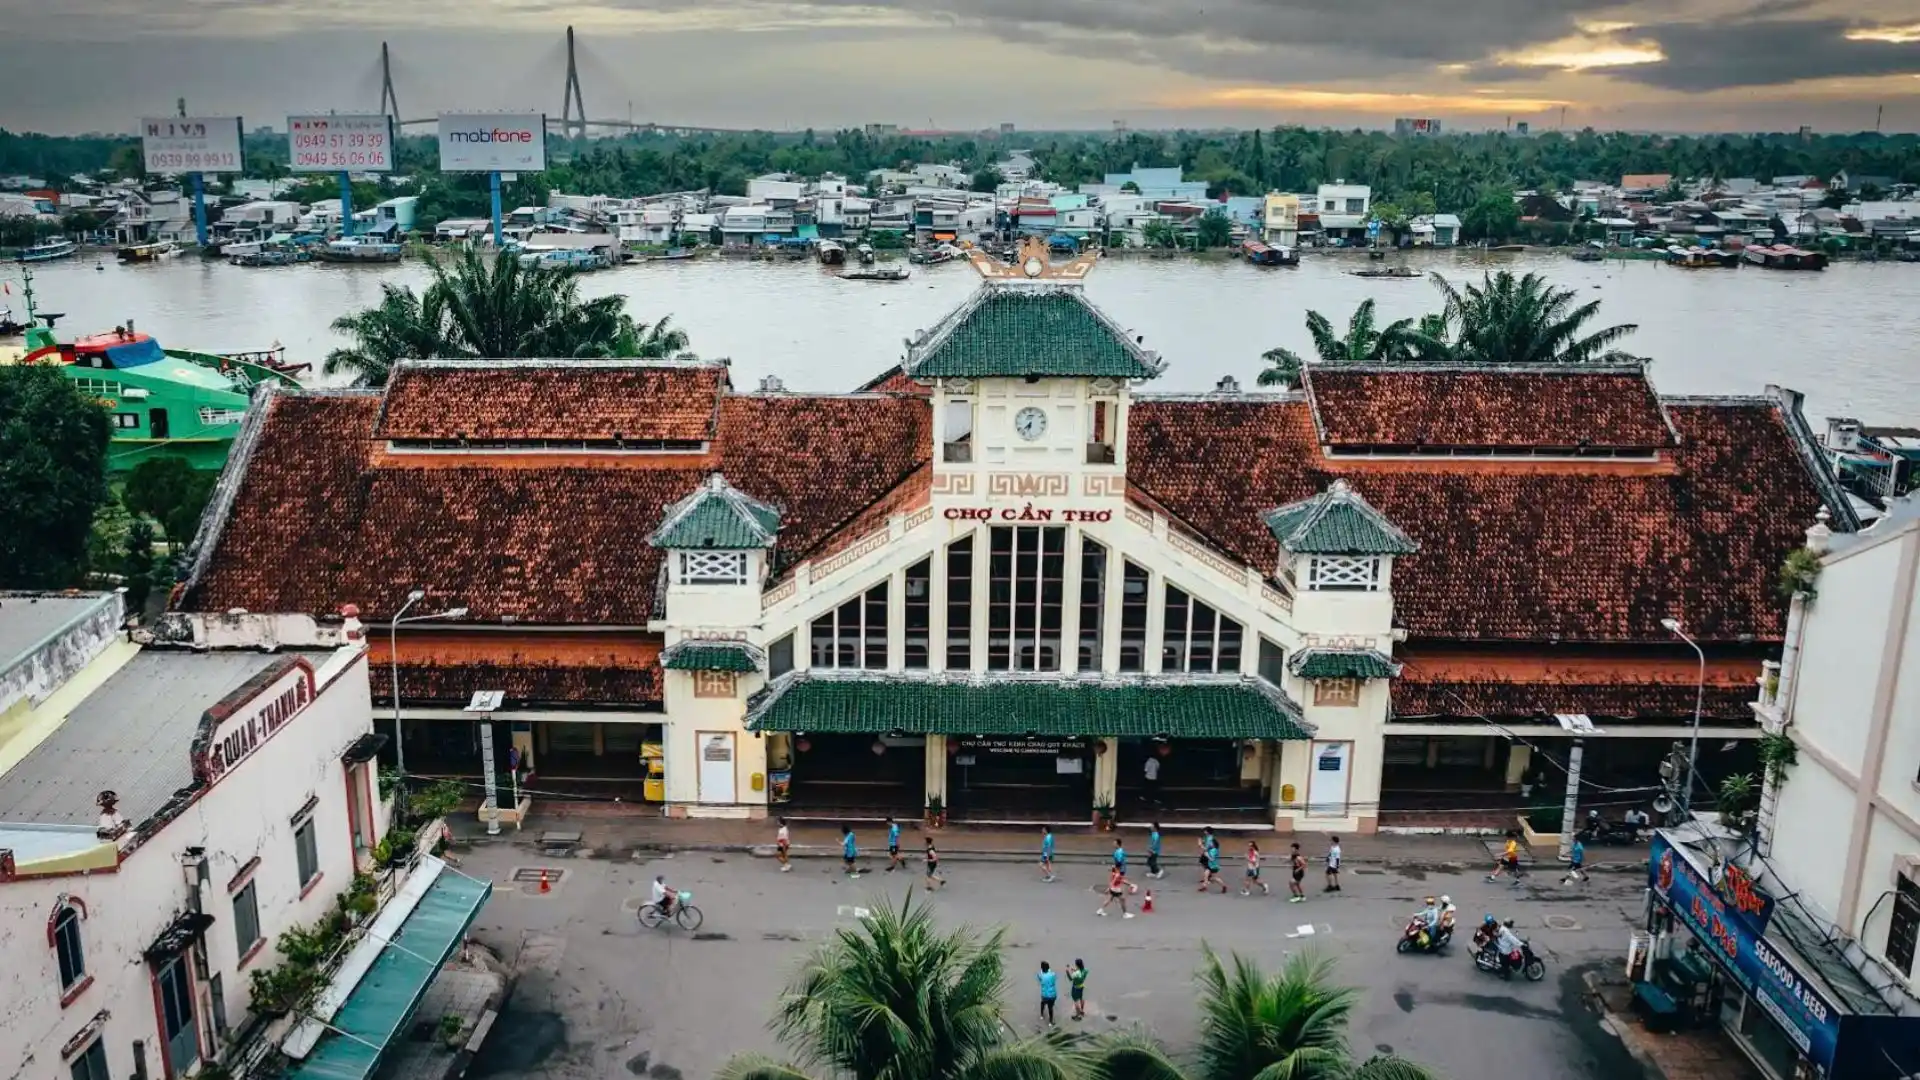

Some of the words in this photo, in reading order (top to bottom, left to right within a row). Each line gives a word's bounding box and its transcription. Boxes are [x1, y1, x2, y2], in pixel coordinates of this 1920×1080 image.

[296, 134, 326, 148] 0949
[330, 134, 343, 148] 51
[348, 134, 364, 148] 39
[368, 134, 383, 147] 39
[450, 127, 532, 143] mobifone
[297, 151, 327, 165] 0949
[331, 151, 346, 165] 56
[350, 151, 365, 165] 06
[369, 151, 384, 165] 06
[943, 507, 993, 523] CHỢ
[1062, 509, 1113, 523] THƠ
[1755, 940, 1794, 988] SEAFOOD
[1795, 982, 1802, 999] &
[1803, 990, 1827, 1024] BEER
